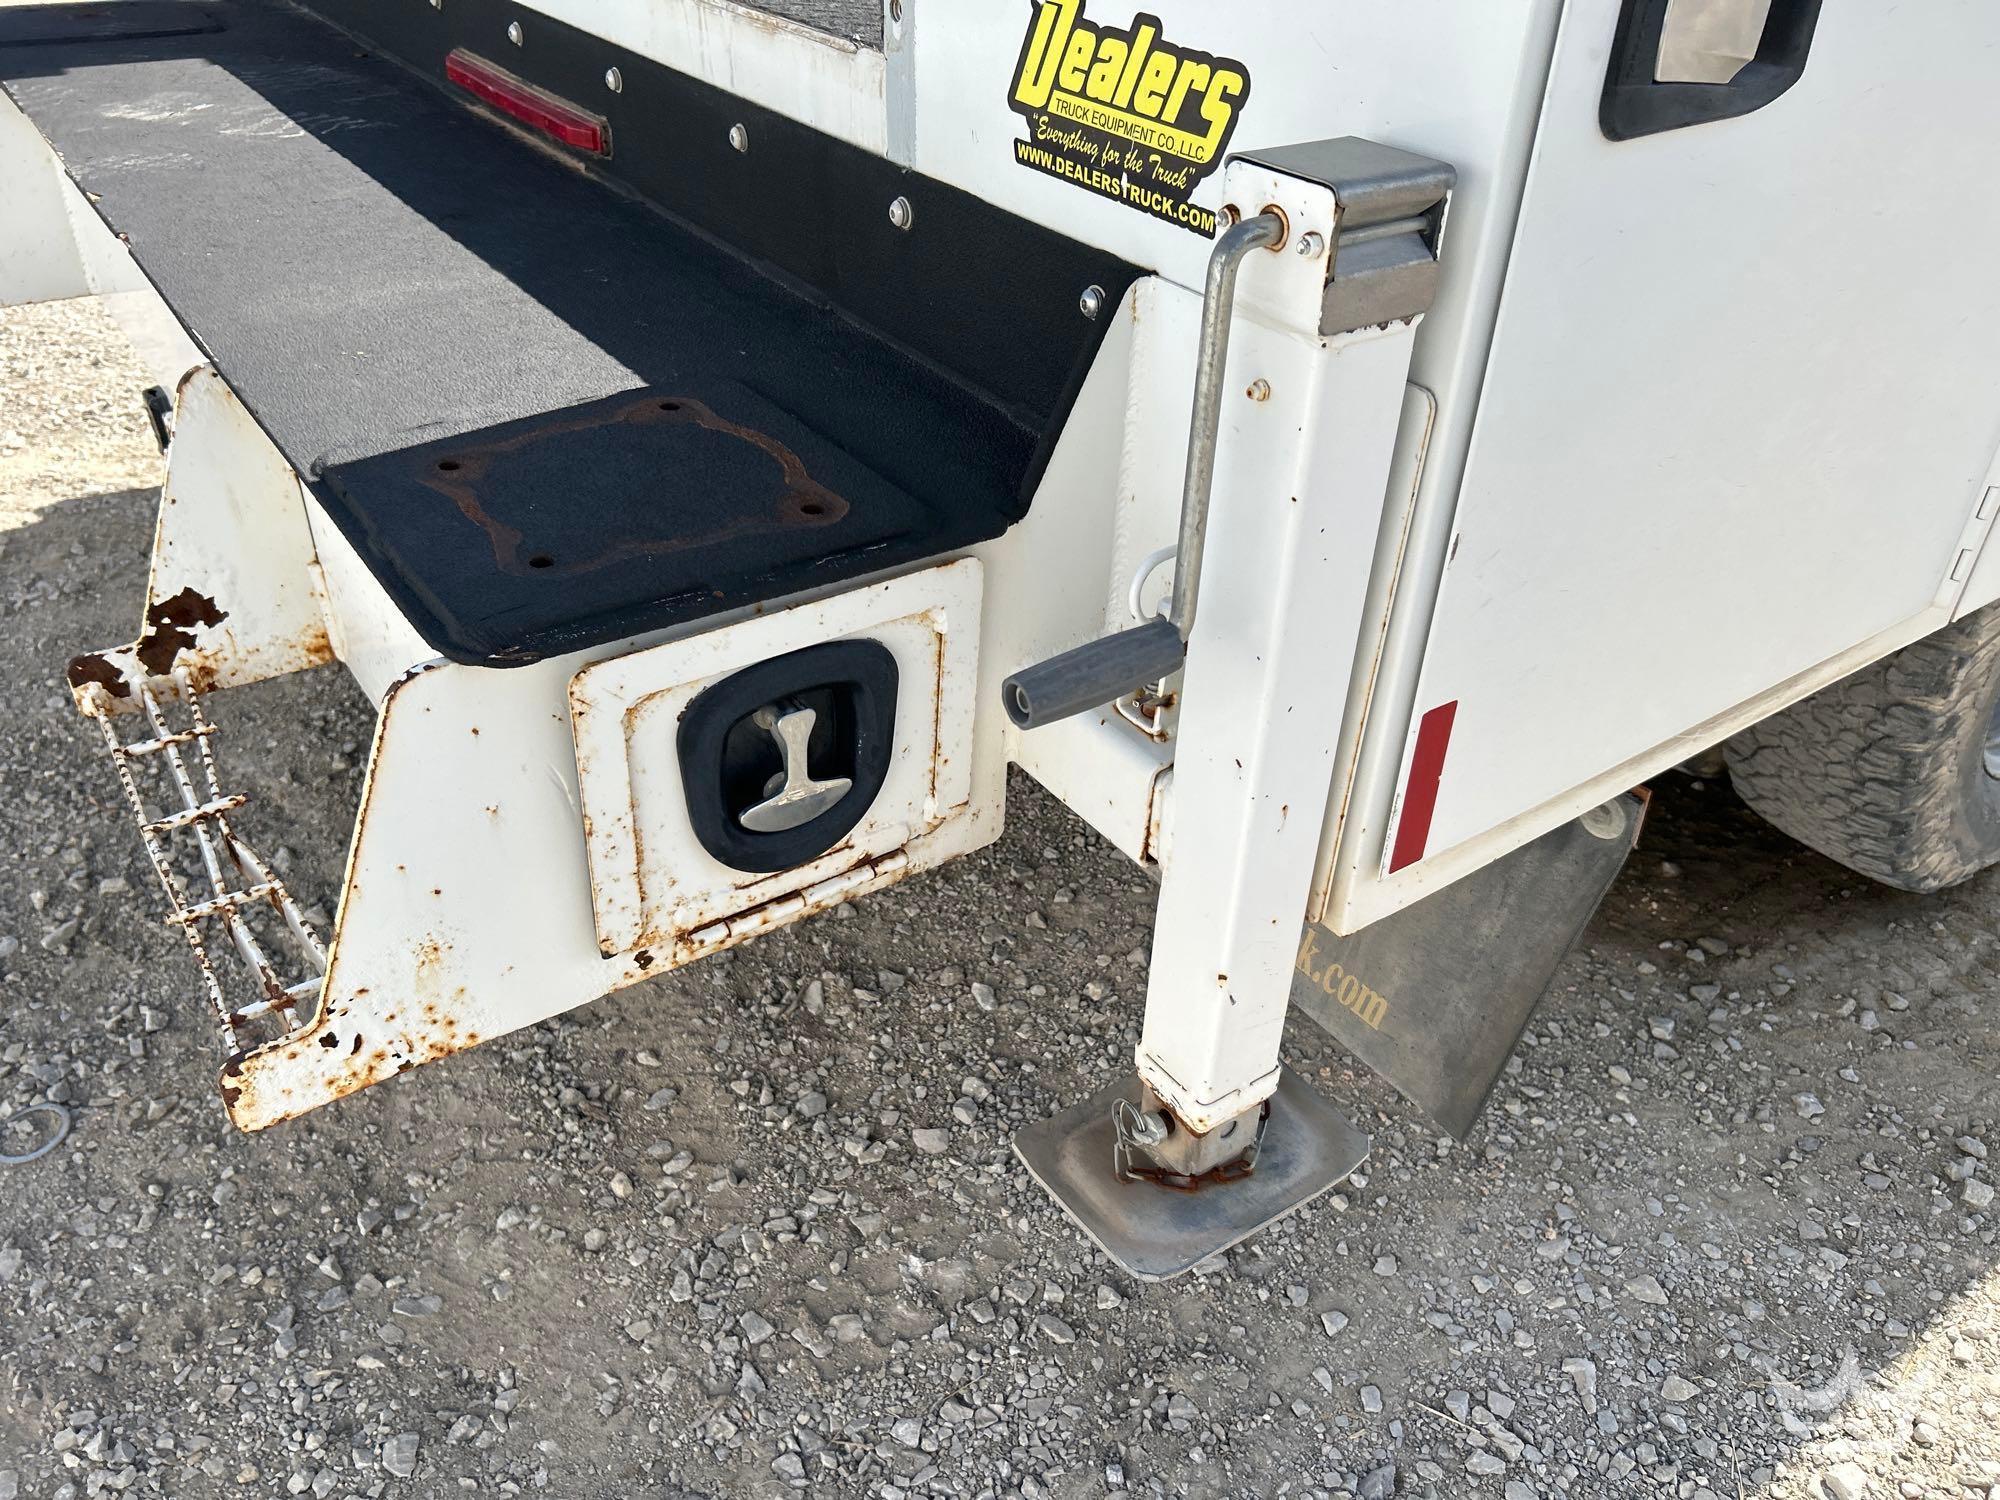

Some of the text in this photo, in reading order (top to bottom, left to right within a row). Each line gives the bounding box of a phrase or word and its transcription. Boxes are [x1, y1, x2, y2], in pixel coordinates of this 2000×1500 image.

[1014, 0, 1244, 139] Dealers
[1055, 97, 1090, 122] TRUCK
[1091, 108, 1157, 144] EQUIPMENT
[1101, 140, 1121, 167] for
[1123, 149, 1143, 172] the
